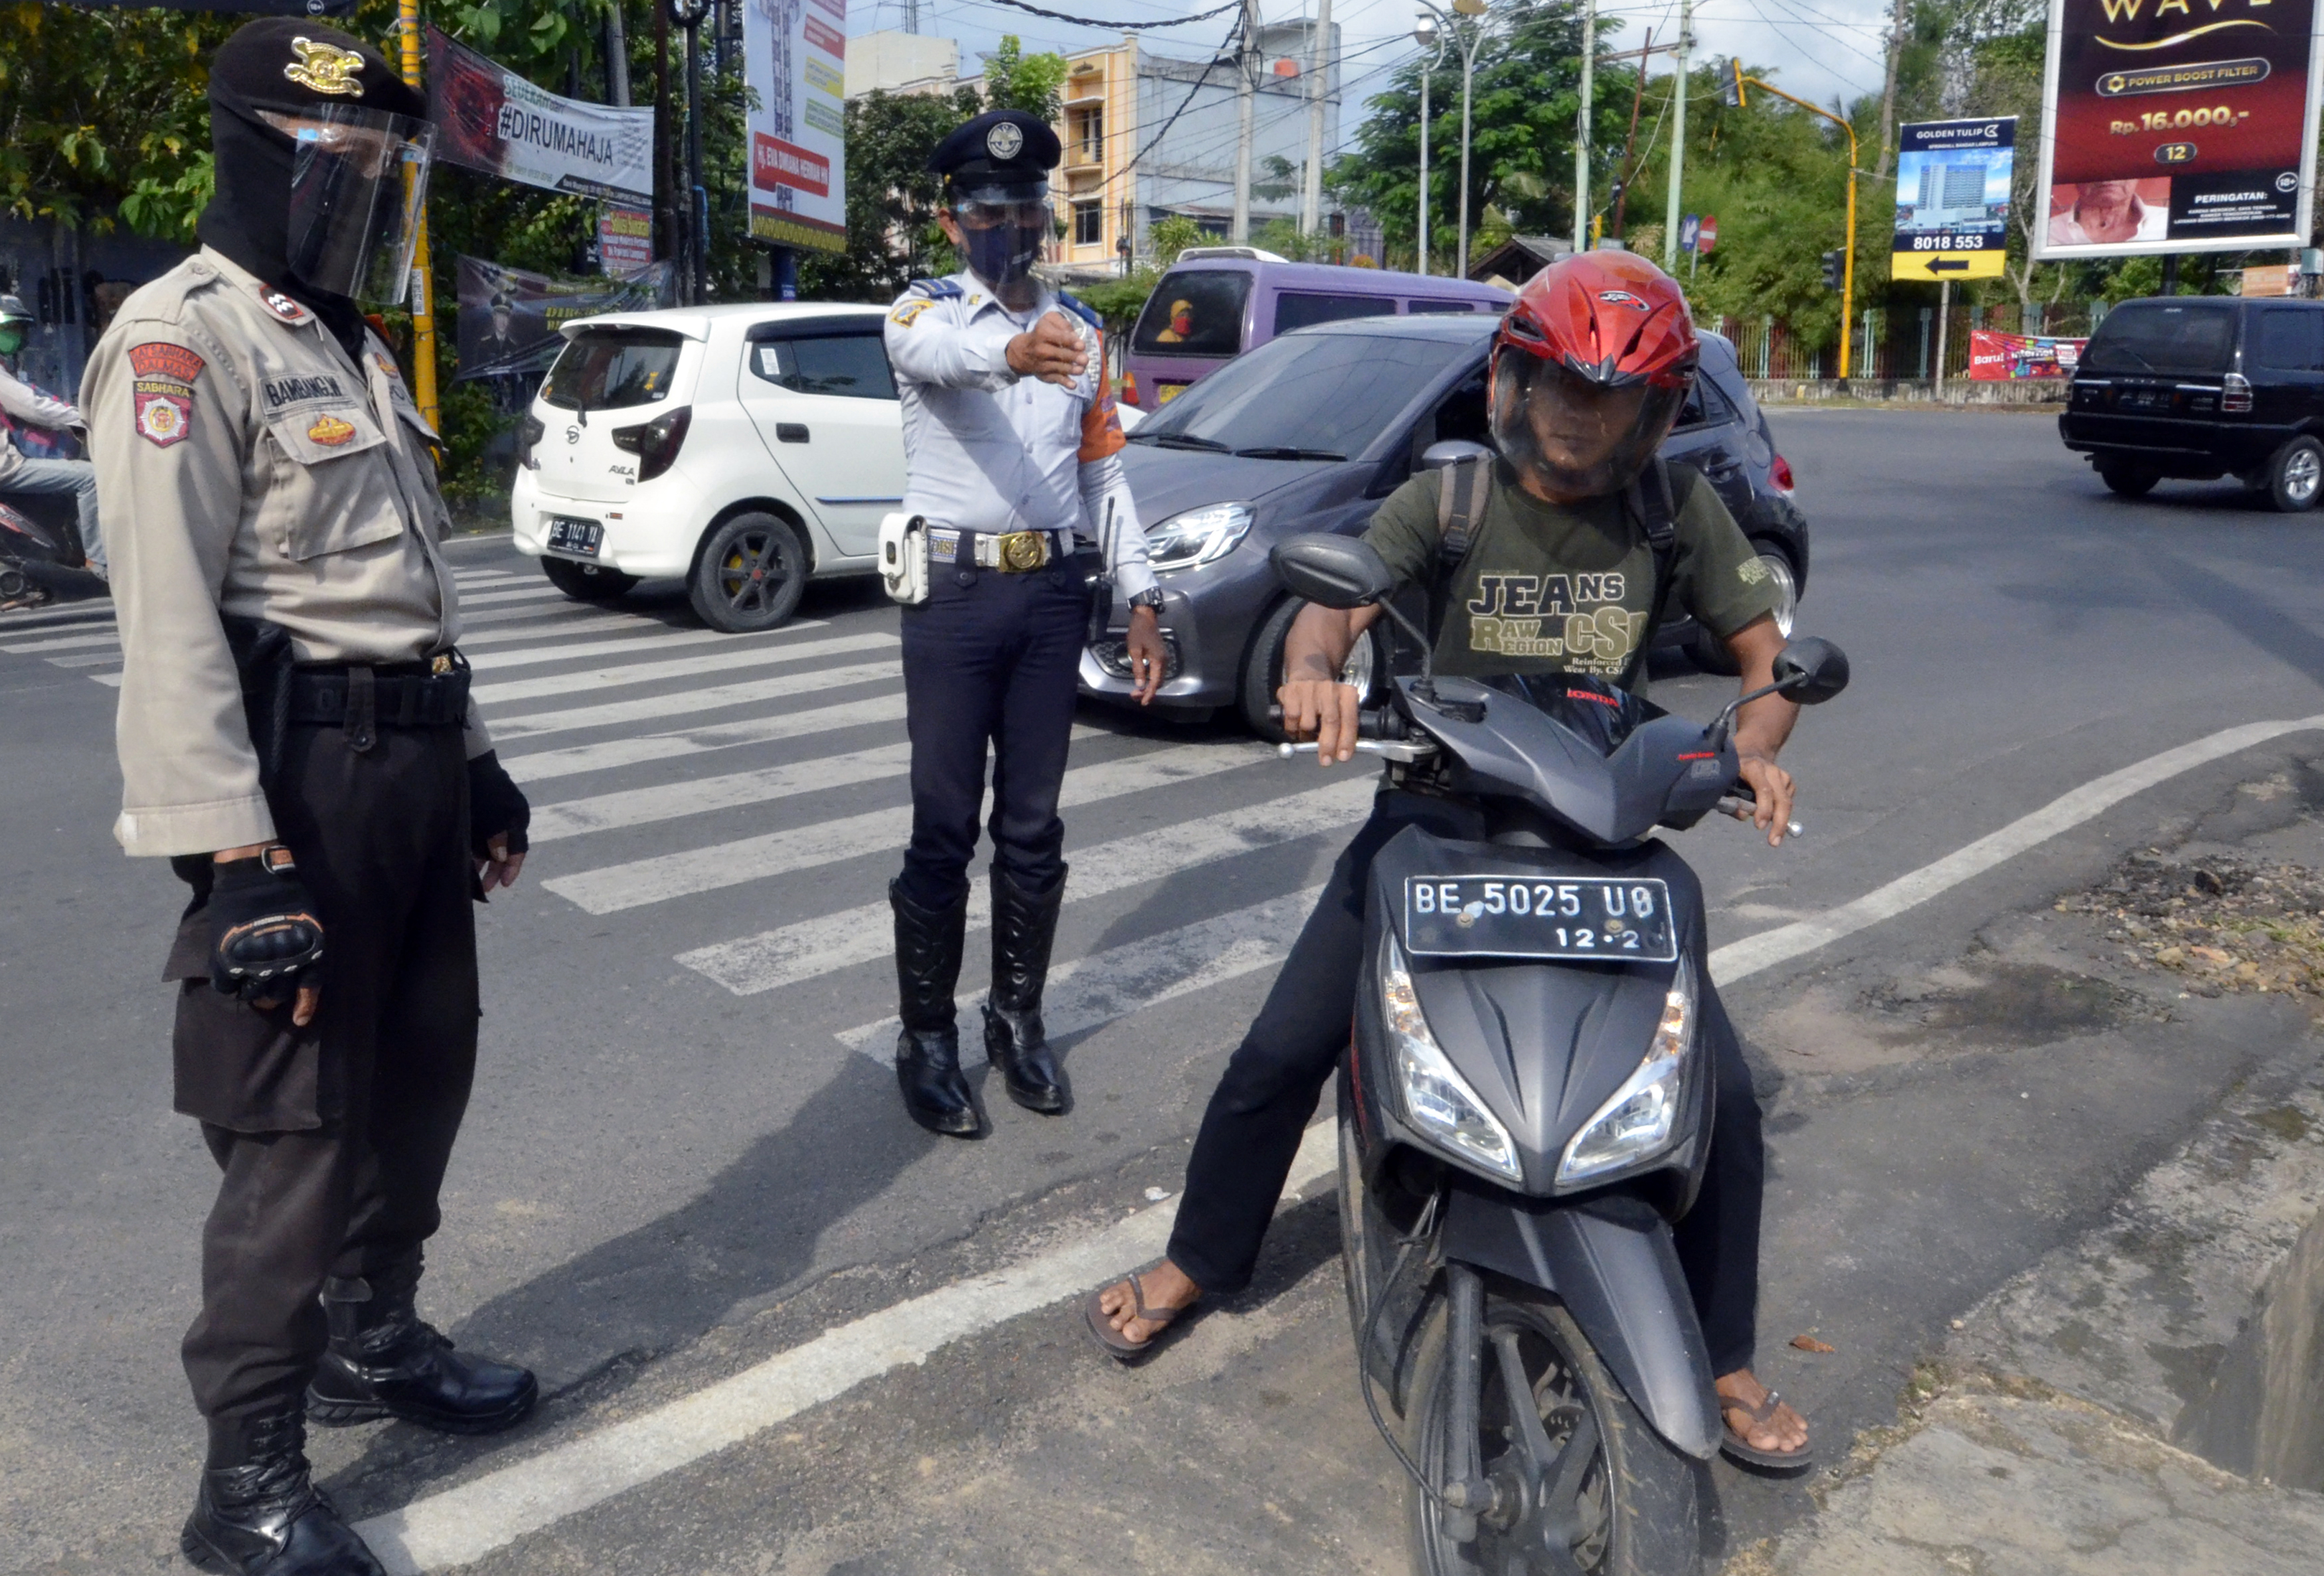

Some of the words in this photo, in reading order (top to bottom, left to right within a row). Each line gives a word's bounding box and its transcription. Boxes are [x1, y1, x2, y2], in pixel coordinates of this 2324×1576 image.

[2128, 74, 2171, 87] POWER
[2173, 70, 2216, 82] BOOST
[2217, 66, 2259, 78] FILTER
[499, 106, 613, 166] #DIRUMAHAJA
[1916, 129, 1955, 139] GOLDEN
[1956, 128, 1983, 137] TULIP
[2165, 145, 2187, 161] 12
[2279, 177, 2296, 187] 18+
[2194, 191, 2268, 204] PERINGATAN:
[1913, 236, 1951, 250] 8018
[1955, 235, 1983, 248] 553
[1974, 352, 2005, 365] Baru!
[137, 382, 190, 397] SABHARA
[1467, 572, 1625, 617] JEANS
[1563, 665, 1586, 673] Wear
[1415, 883, 1461, 913] BE
[1484, 883, 1581, 917] 5025
